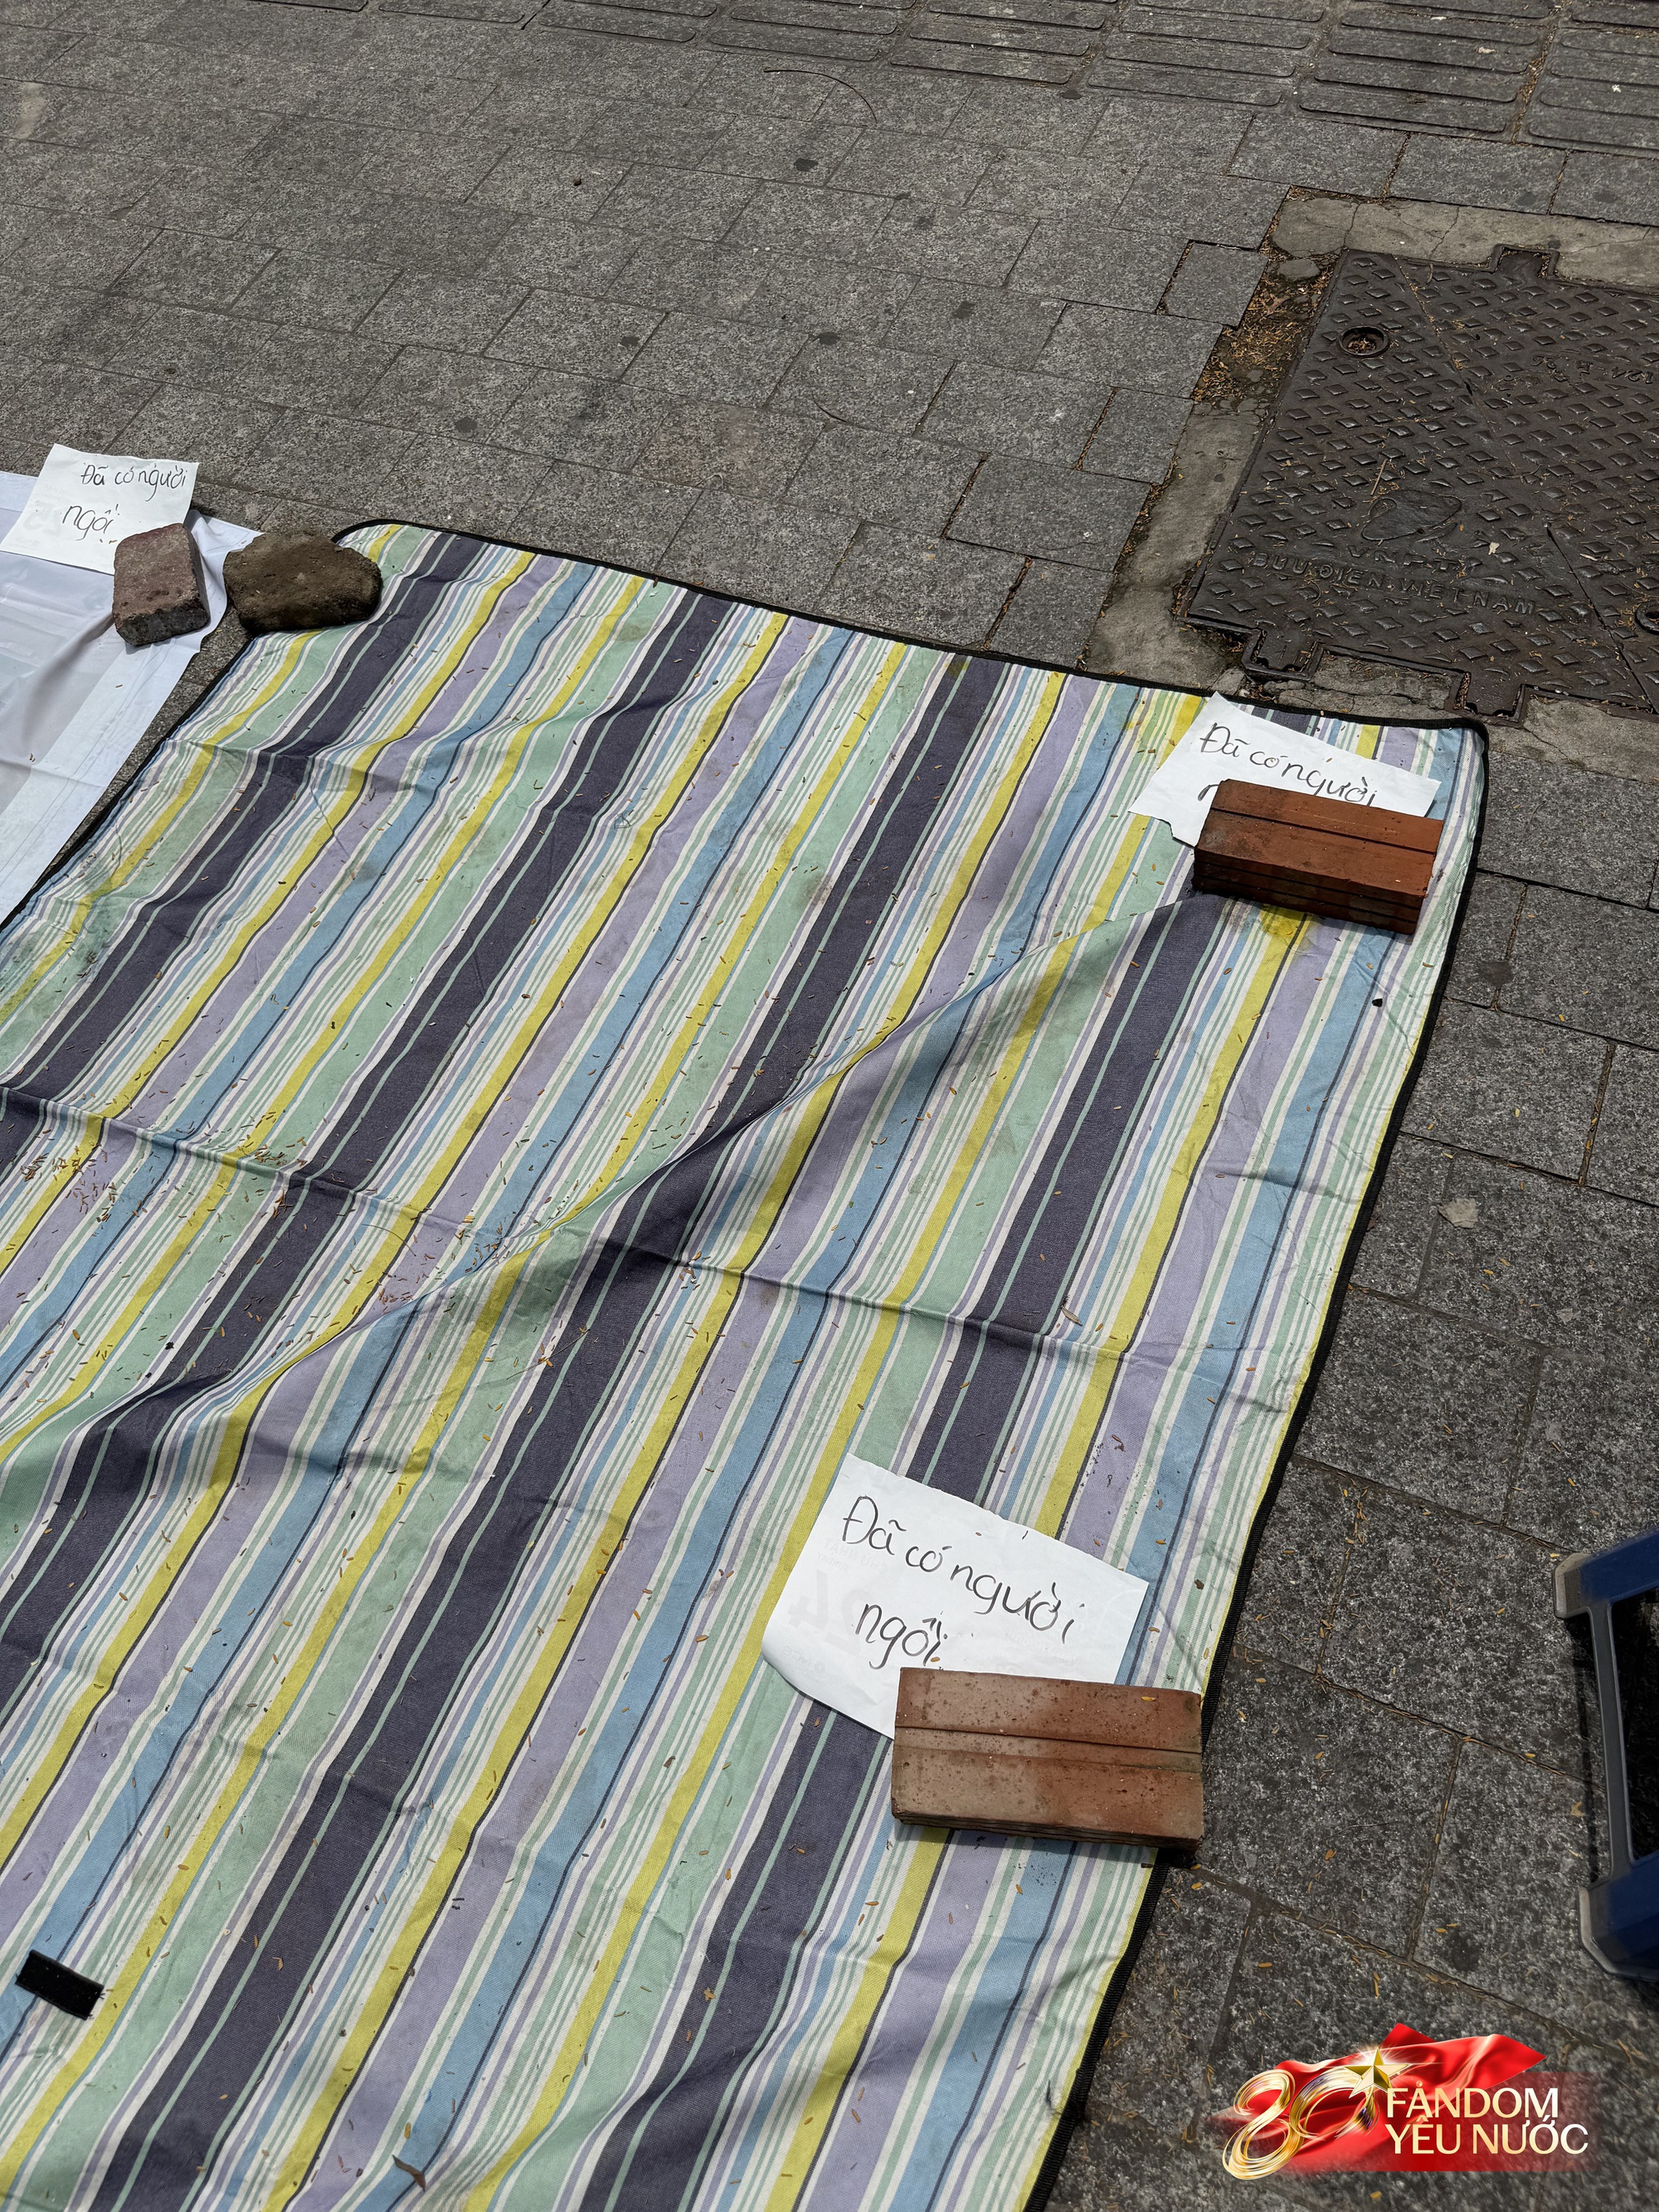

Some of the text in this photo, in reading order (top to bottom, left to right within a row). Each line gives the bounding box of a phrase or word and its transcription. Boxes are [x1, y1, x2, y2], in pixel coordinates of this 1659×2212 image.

[80, 464, 188, 502] Đã có người
[1199, 722, 1379, 807] Đã có người
[841, 1495, 907, 1556] Đã
[905, 1544, 953, 1573] có
[950, 1564, 1086, 1644] người
